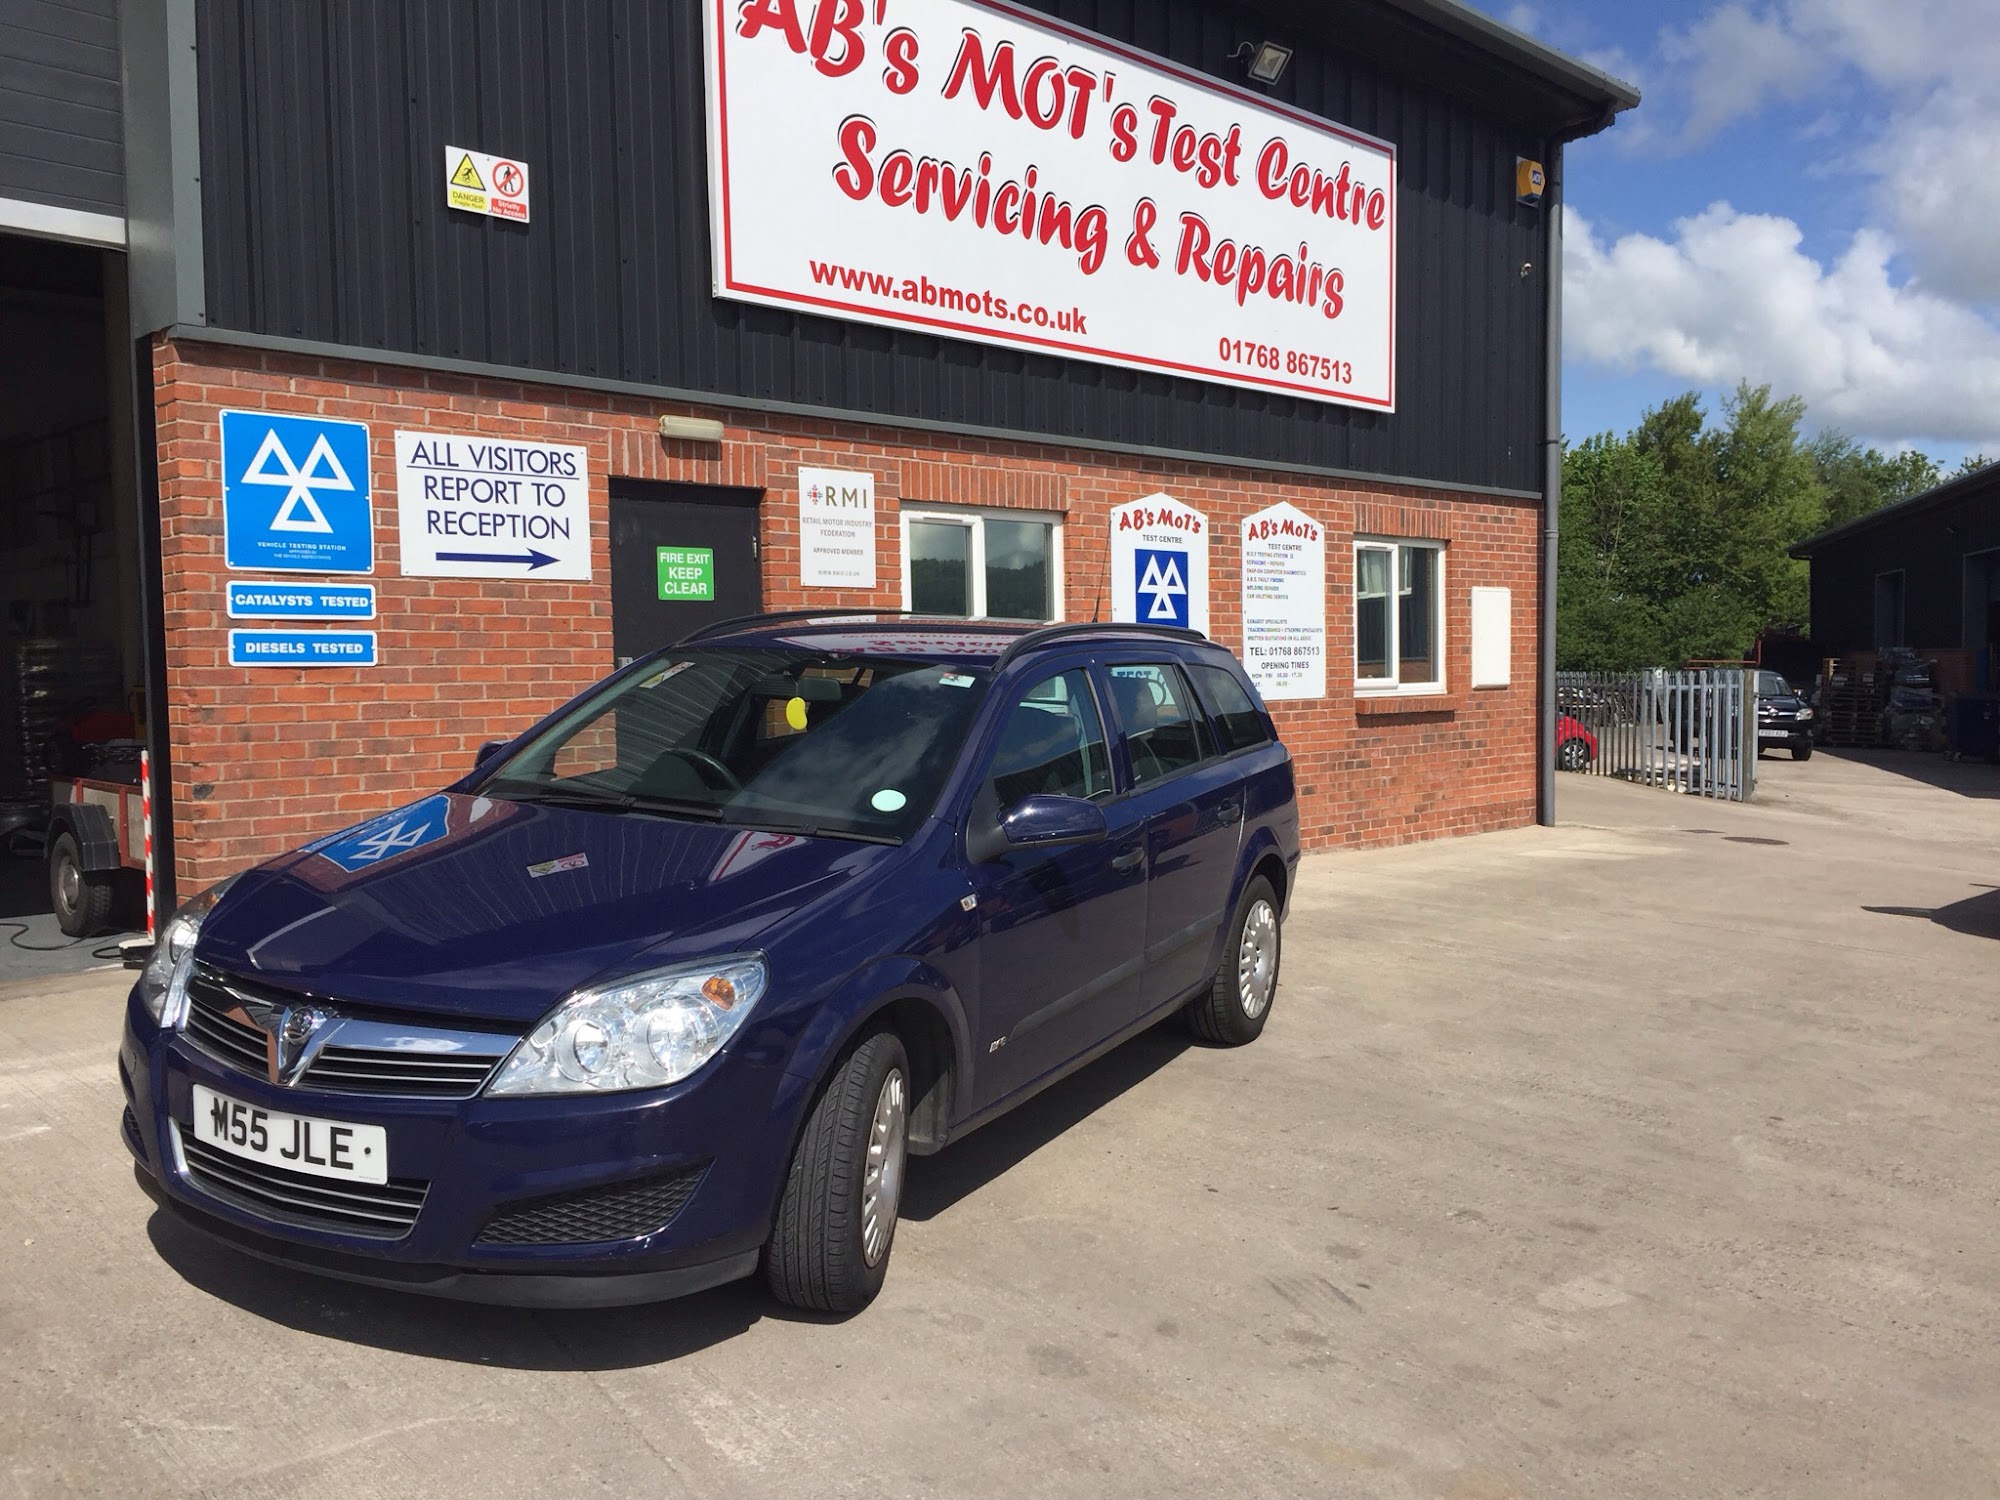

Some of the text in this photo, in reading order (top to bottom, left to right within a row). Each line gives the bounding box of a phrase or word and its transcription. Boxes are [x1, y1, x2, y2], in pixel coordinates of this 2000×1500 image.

[737, 0, 1385, 231] AB's MOT's Test Centre
[452, 192, 485, 204] DANGER
[498, 200, 520, 212] Strictly
[503, 207, 526, 218] Access
[834, 115, 1345, 320] Servicing & Repairs
[809, 260, 1087, 335] www.abmots.co.uk
[1219, 337, 1352, 384] 01768 867513
[411, 440, 577, 476] ALL VISITORS
[424, 475, 566, 507] REPORT TO
[825, 486, 868, 509] RMI
[427, 510, 570, 540] RECEPTION
[802, 517, 873, 528] RETAIL MOTOR INDUSTRY
[1119, 508, 1155, 532] AB's
[820, 529, 856, 538] FEDERATION
[1248, 518, 1278, 541] AB's
[1142, 534, 1158, 542] TEST
[257, 541, 347, 552] VEHICLE TESTING STATION
[813, 547, 841, 555] APPROVED
[660, 552, 711, 565] FIRE EXIT
[668, 567, 703, 580] KEEP
[664, 581, 708, 595] CLEAR
[235, 594, 369, 607] CATALYSTS TESTED
[245, 642, 364, 654] DIESELS TESTED
[1249, 646, 1320, 656] TEL: 01768 867513
[1290, 661, 1310, 669] TIMES
[213, 1097, 354, 1170] M55 JLE
